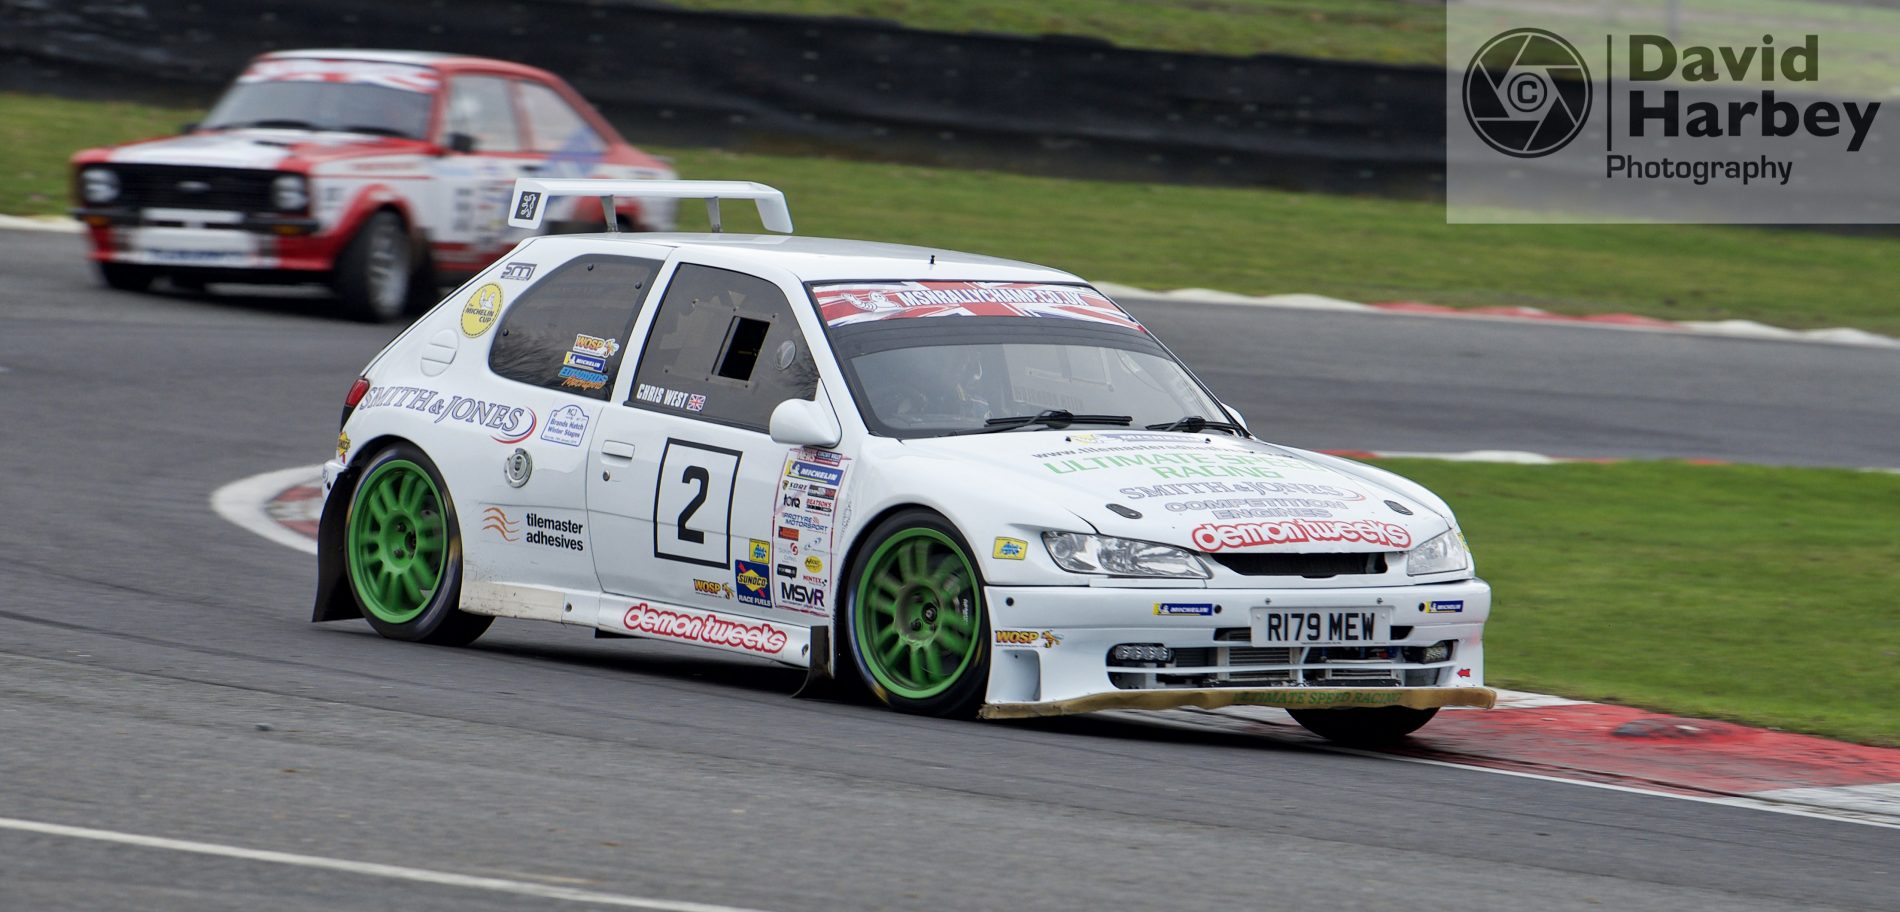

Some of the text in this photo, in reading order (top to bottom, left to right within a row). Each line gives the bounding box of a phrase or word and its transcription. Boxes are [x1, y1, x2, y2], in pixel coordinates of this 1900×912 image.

[897, 288, 1089, 307] MSNRALLYCHAMP.CO.UK
[465, 307, 494, 317] MICHELIN
[576, 335, 604, 351] WOSP
[575, 358, 601, 368] MICHELIN
[636, 383, 689, 408] CHRIS WEST
[550, 418, 584, 430] Brands Hatch
[547, 426, 580, 438] Winter Stages
[1043, 452, 1327, 475] ULTIMATE SPEED
[800, 468, 838, 481] MICHELIN
[1151, 465, 1285, 479] RACING
[677, 465, 710, 545] 2
[1165, 498, 1349, 512] COMPETITION
[783, 512, 813, 523] PROTYRE
[1211, 508, 1334, 520] ENGINES
[526, 512, 583, 534] tilemaster
[785, 518, 828, 532] MOTORSPORT
[526, 531, 584, 551] adhesives
[1192, 517, 1411, 554] demon tweeks
[693, 578, 722, 595] WOSP
[738, 574, 767, 587] SUNOCO
[738, 594, 753, 604] RACE
[754, 597, 772, 607] FUELS
[781, 582, 825, 607] MSVR
[1169, 606, 1210, 614] MICHELIN
[624, 603, 788, 654] demon tweeks
[1267, 612, 1375, 642] R179 MEW
[994, 630, 1040, 644] WOSP
[1232, 691, 1402, 705] ULTIMATE SPEED RACING
